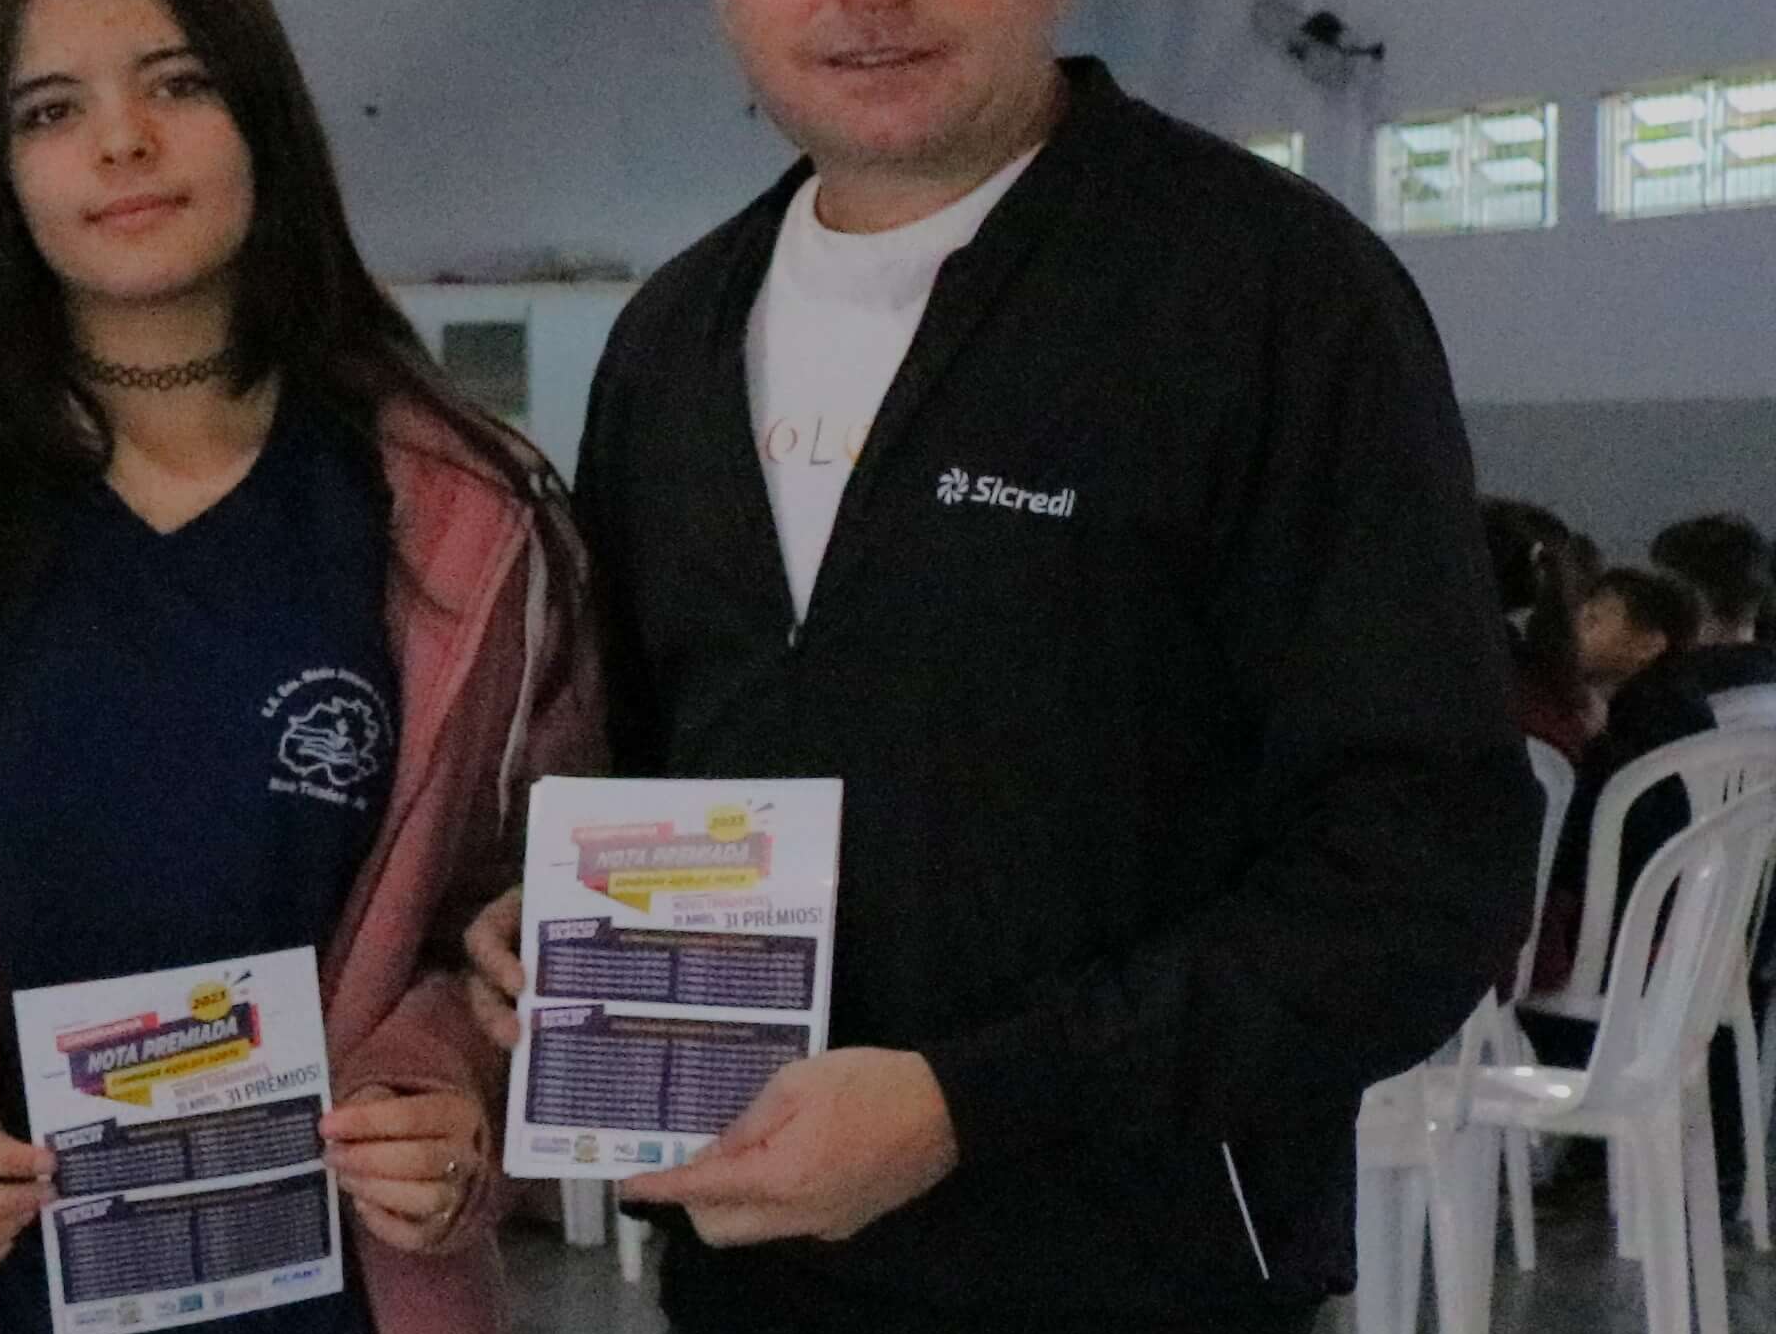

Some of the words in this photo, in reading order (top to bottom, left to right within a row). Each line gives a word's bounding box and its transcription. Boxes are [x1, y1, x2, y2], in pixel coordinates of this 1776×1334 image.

[969, 474, 1077, 518] Sicredi
[88, 1042, 138, 1073] NOTA
[140, 1016, 239, 1062] PREMIADA
